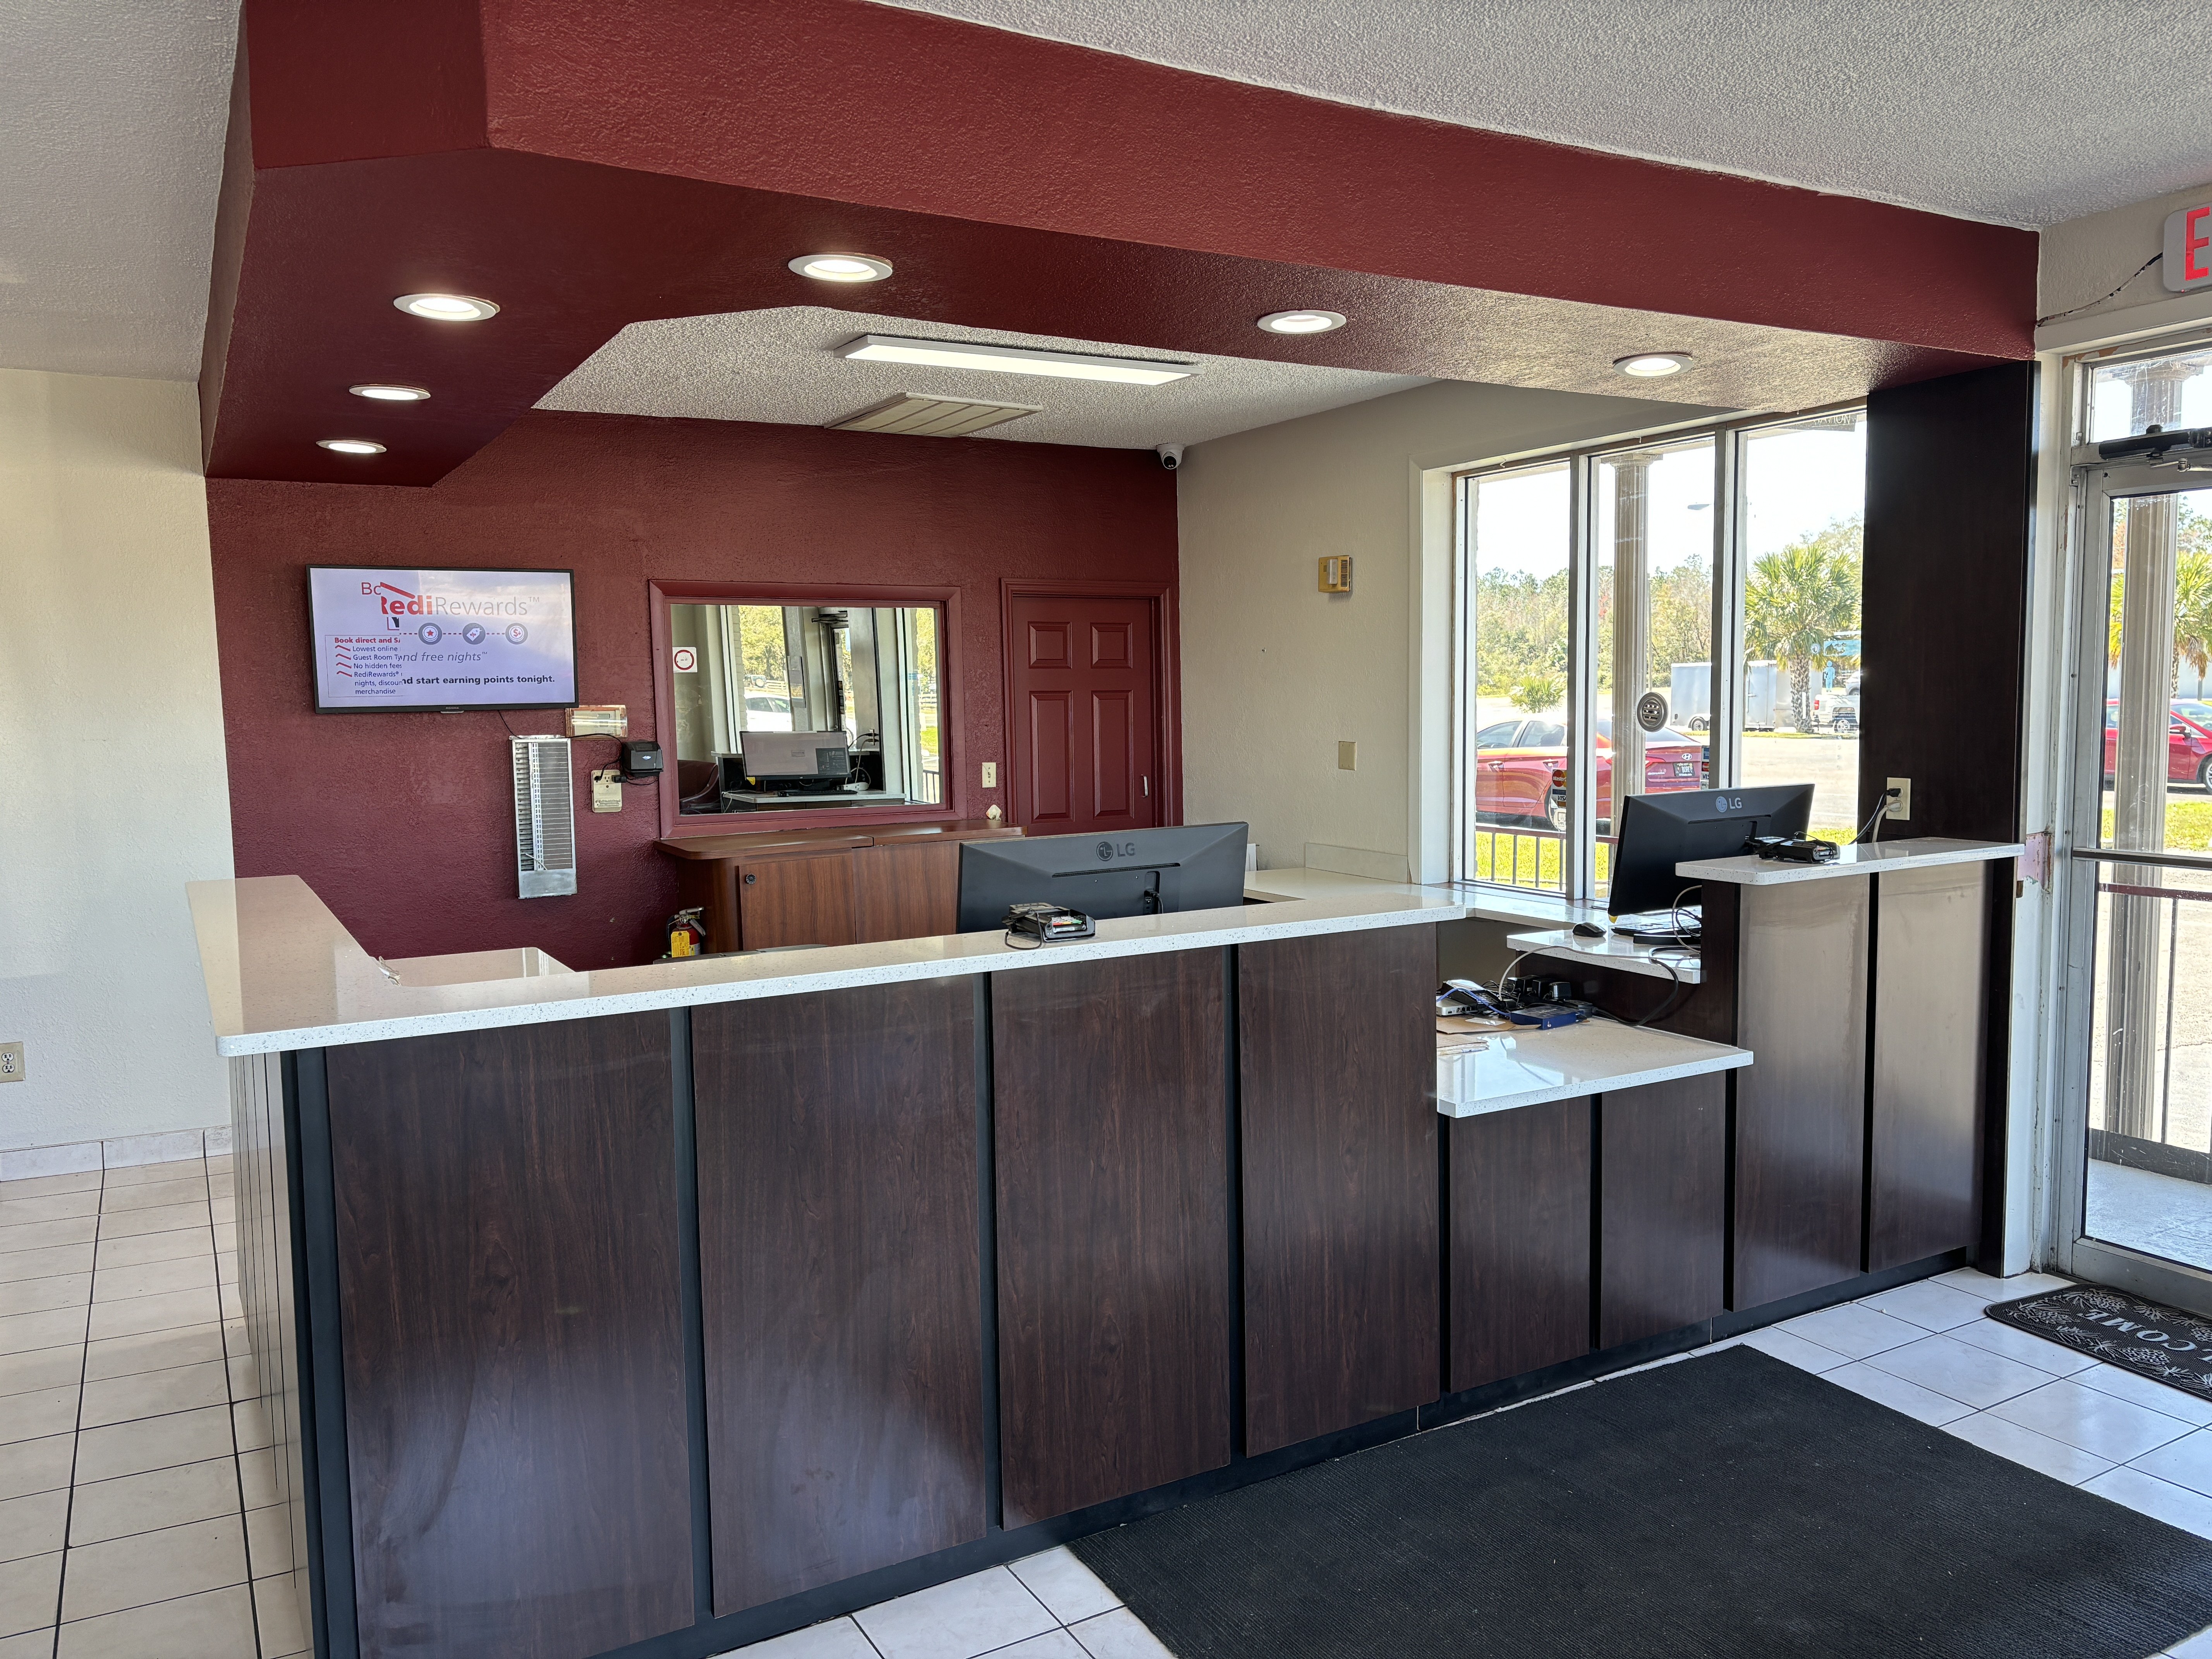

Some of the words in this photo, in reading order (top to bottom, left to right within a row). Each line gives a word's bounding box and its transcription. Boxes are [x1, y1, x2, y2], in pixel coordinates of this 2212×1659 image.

[2185, 206, 2210, 281] E
[421, 652, 443, 661] free
[443, 676, 480, 685] earning
[484, 676, 514, 685] points
[517, 675, 555, 684] tonight.
[1729, 797, 1742, 809] LG
[1116, 842, 1135, 857] LG
